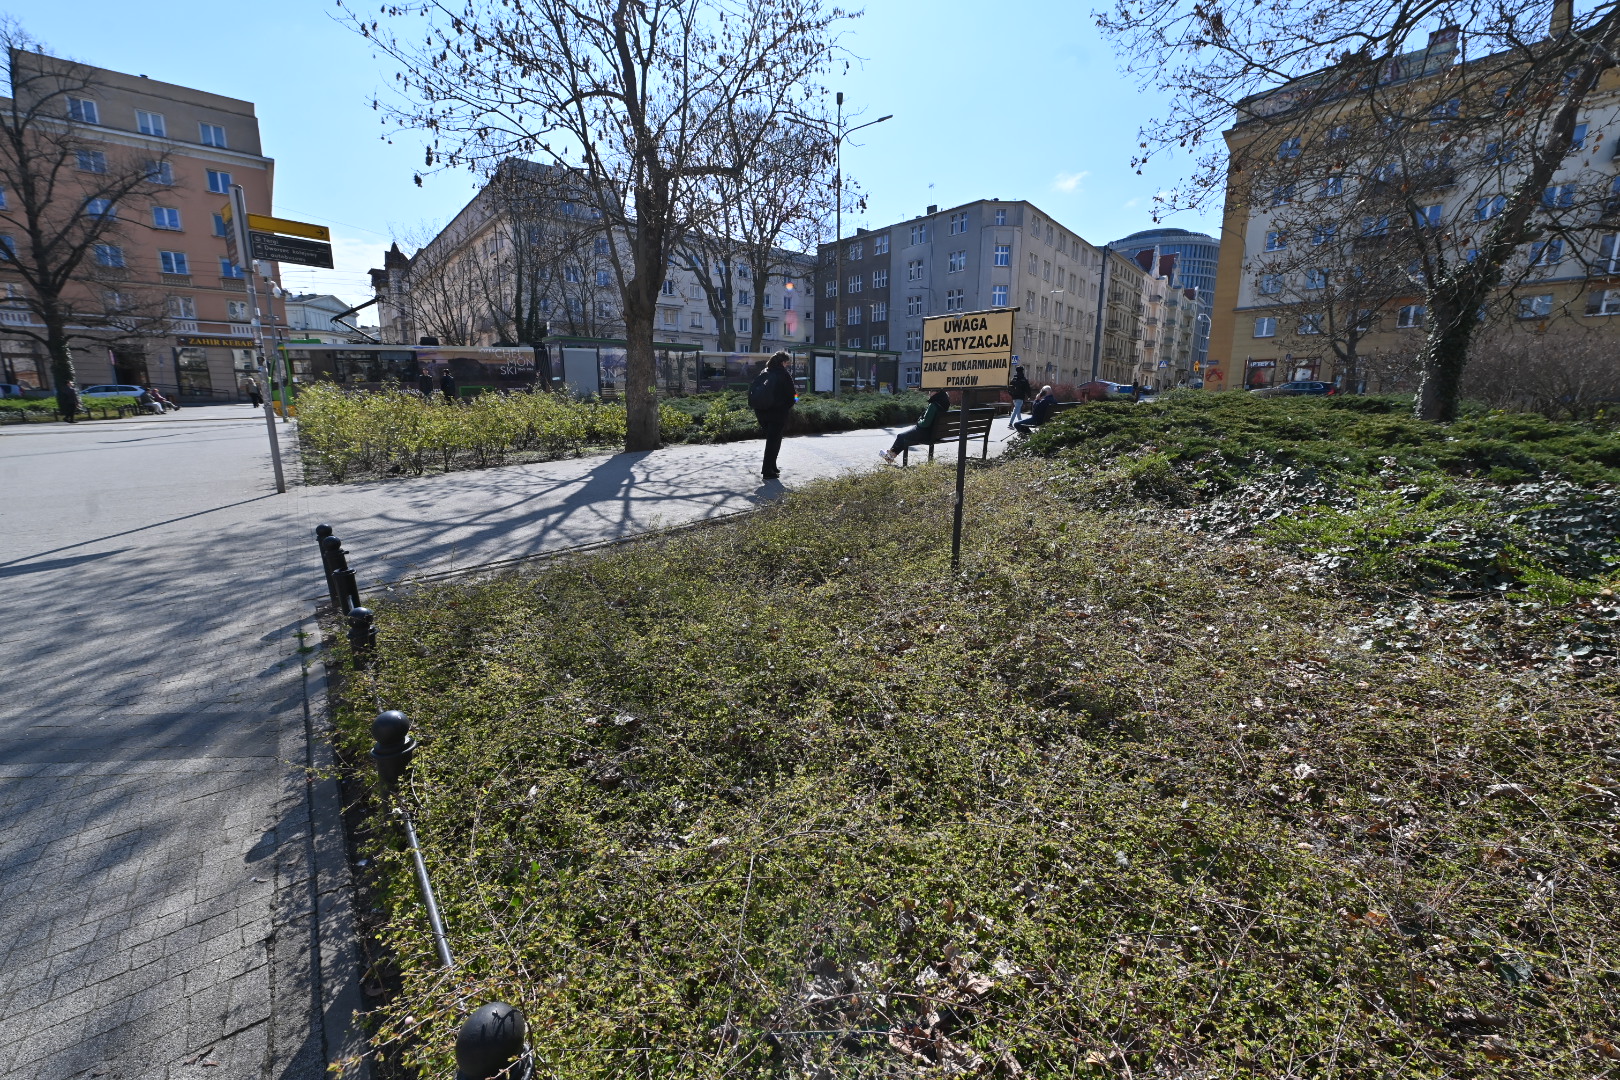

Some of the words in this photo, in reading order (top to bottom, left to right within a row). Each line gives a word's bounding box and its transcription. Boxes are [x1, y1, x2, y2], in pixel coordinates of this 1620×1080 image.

[943, 317, 988, 333] UWAGA
[189, 338, 220, 346] ZAHIR
[222, 339, 253, 347] KEBAB
[924, 334, 1010, 353] DERATYZACJA
[923, 361, 948, 372] ZAKAZ
[951, 358, 1007, 371] DOKARMIANIA
[946, 374, 979, 386] PTAKÓW
